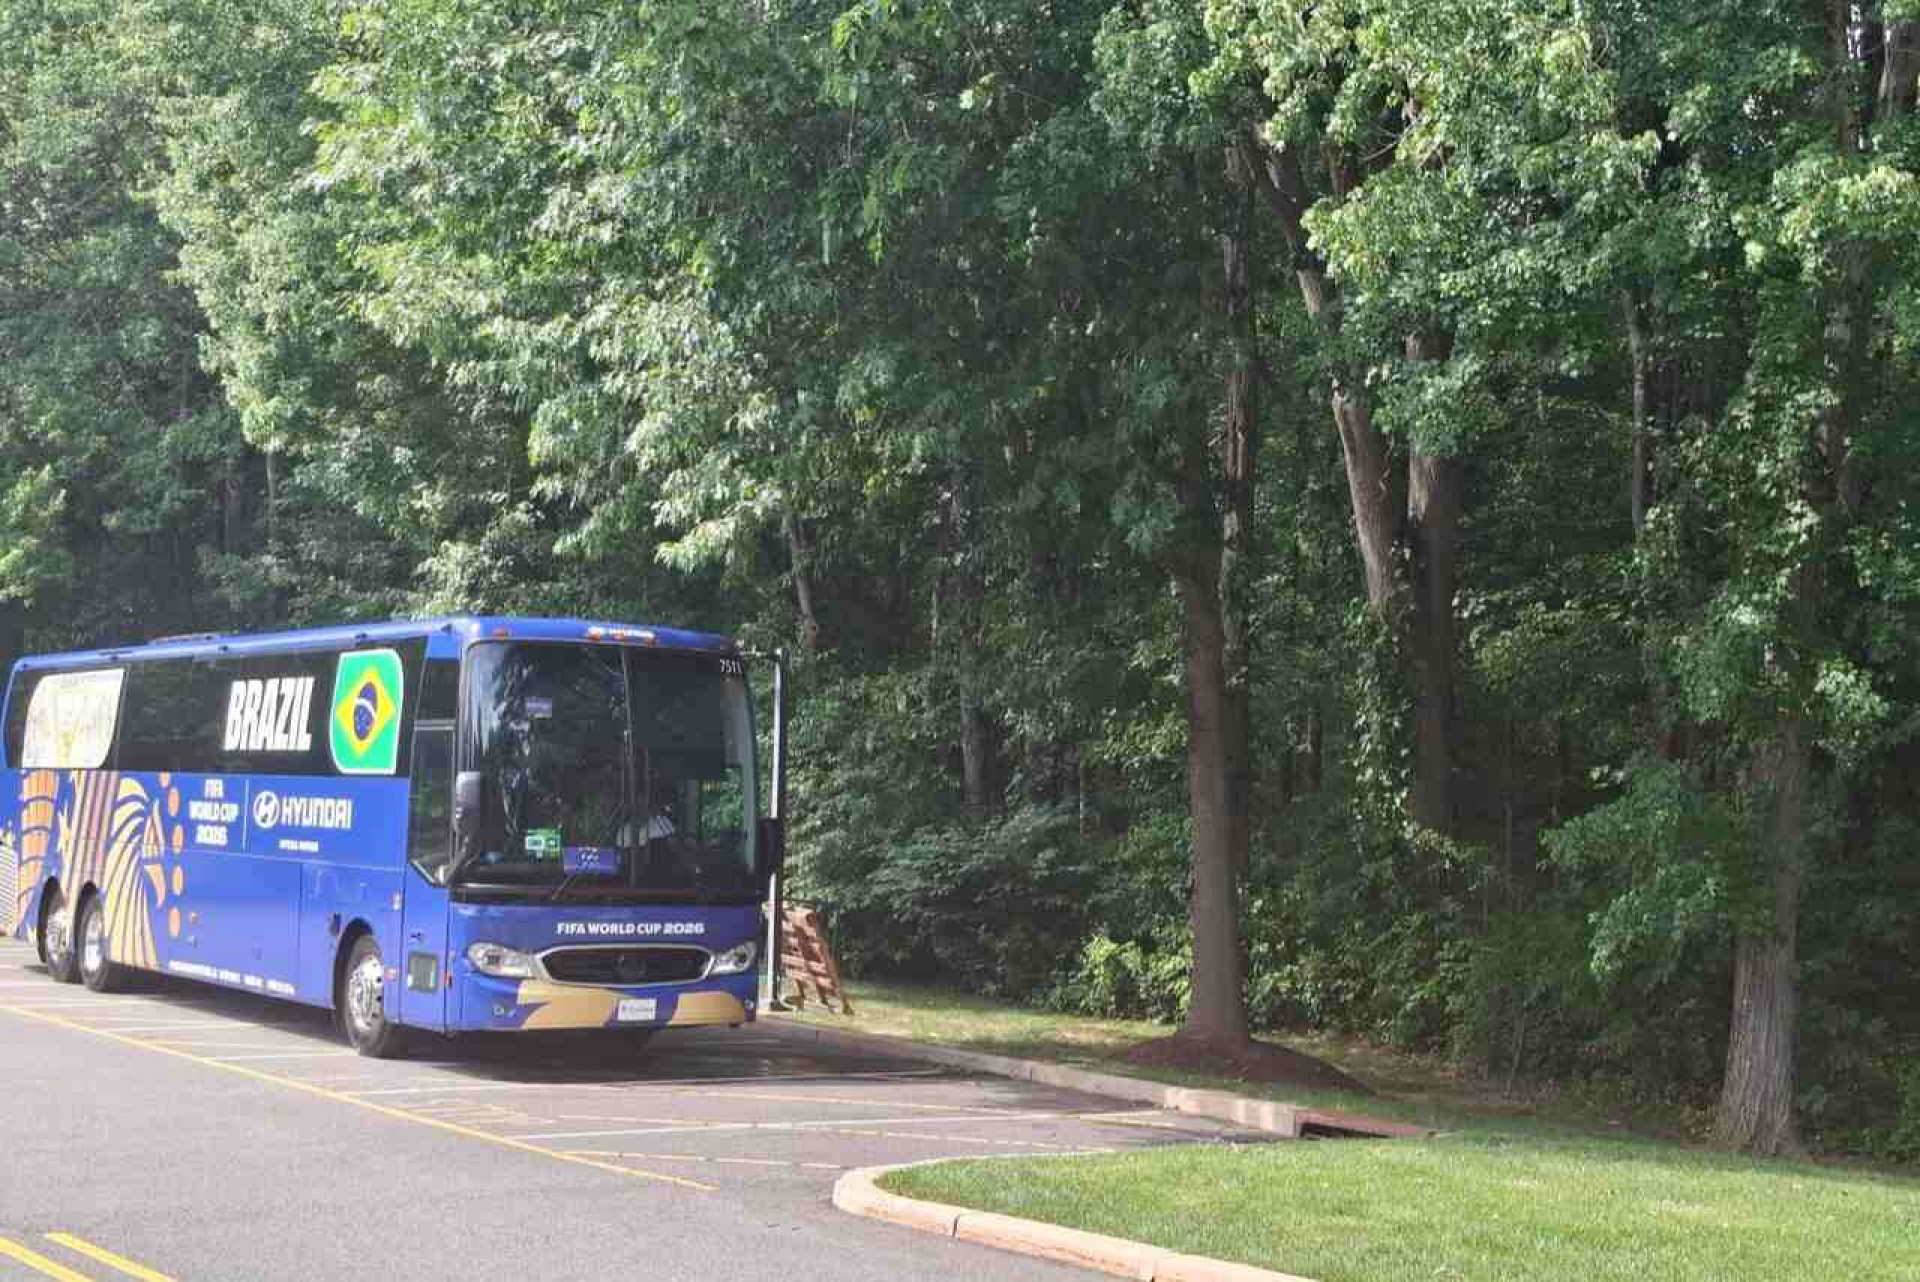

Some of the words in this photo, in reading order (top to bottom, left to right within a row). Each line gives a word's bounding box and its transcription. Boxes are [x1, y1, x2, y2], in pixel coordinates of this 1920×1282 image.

[224, 676, 315, 751] BRAZIL
[281, 796, 352, 829] HYUNDAI
[557, 922, 586, 935] FIFA
[587, 922, 635, 935] WORLD
[636, 923, 662, 935] CUP
[662, 923, 705, 935] 2026
